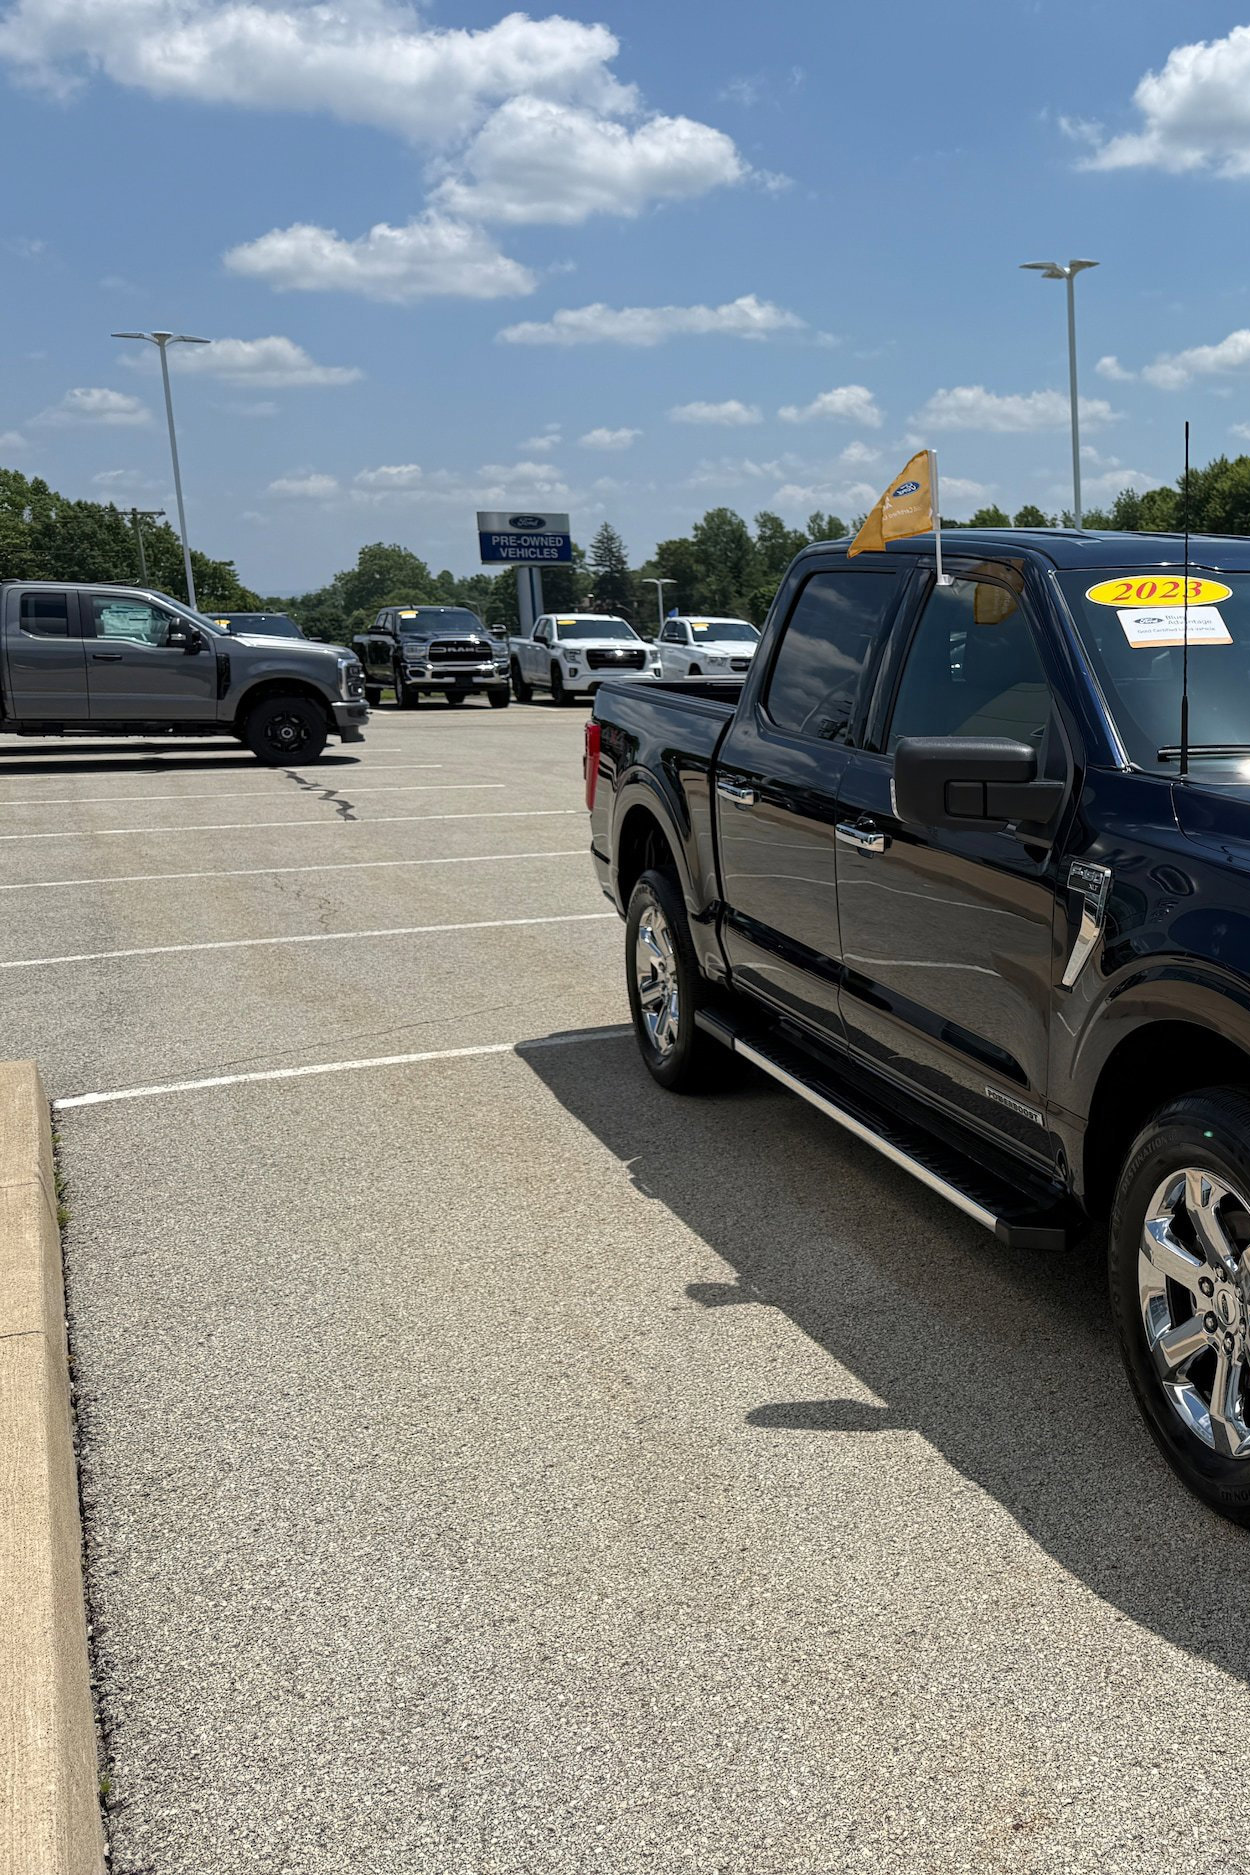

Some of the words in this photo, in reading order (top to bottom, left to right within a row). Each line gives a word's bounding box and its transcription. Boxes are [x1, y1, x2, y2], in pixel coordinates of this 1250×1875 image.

[491, 535, 564, 547] PRE-OWNED
[499, 548, 559, 559] VEHICLES
[1111, 580, 1203, 601] 2023
